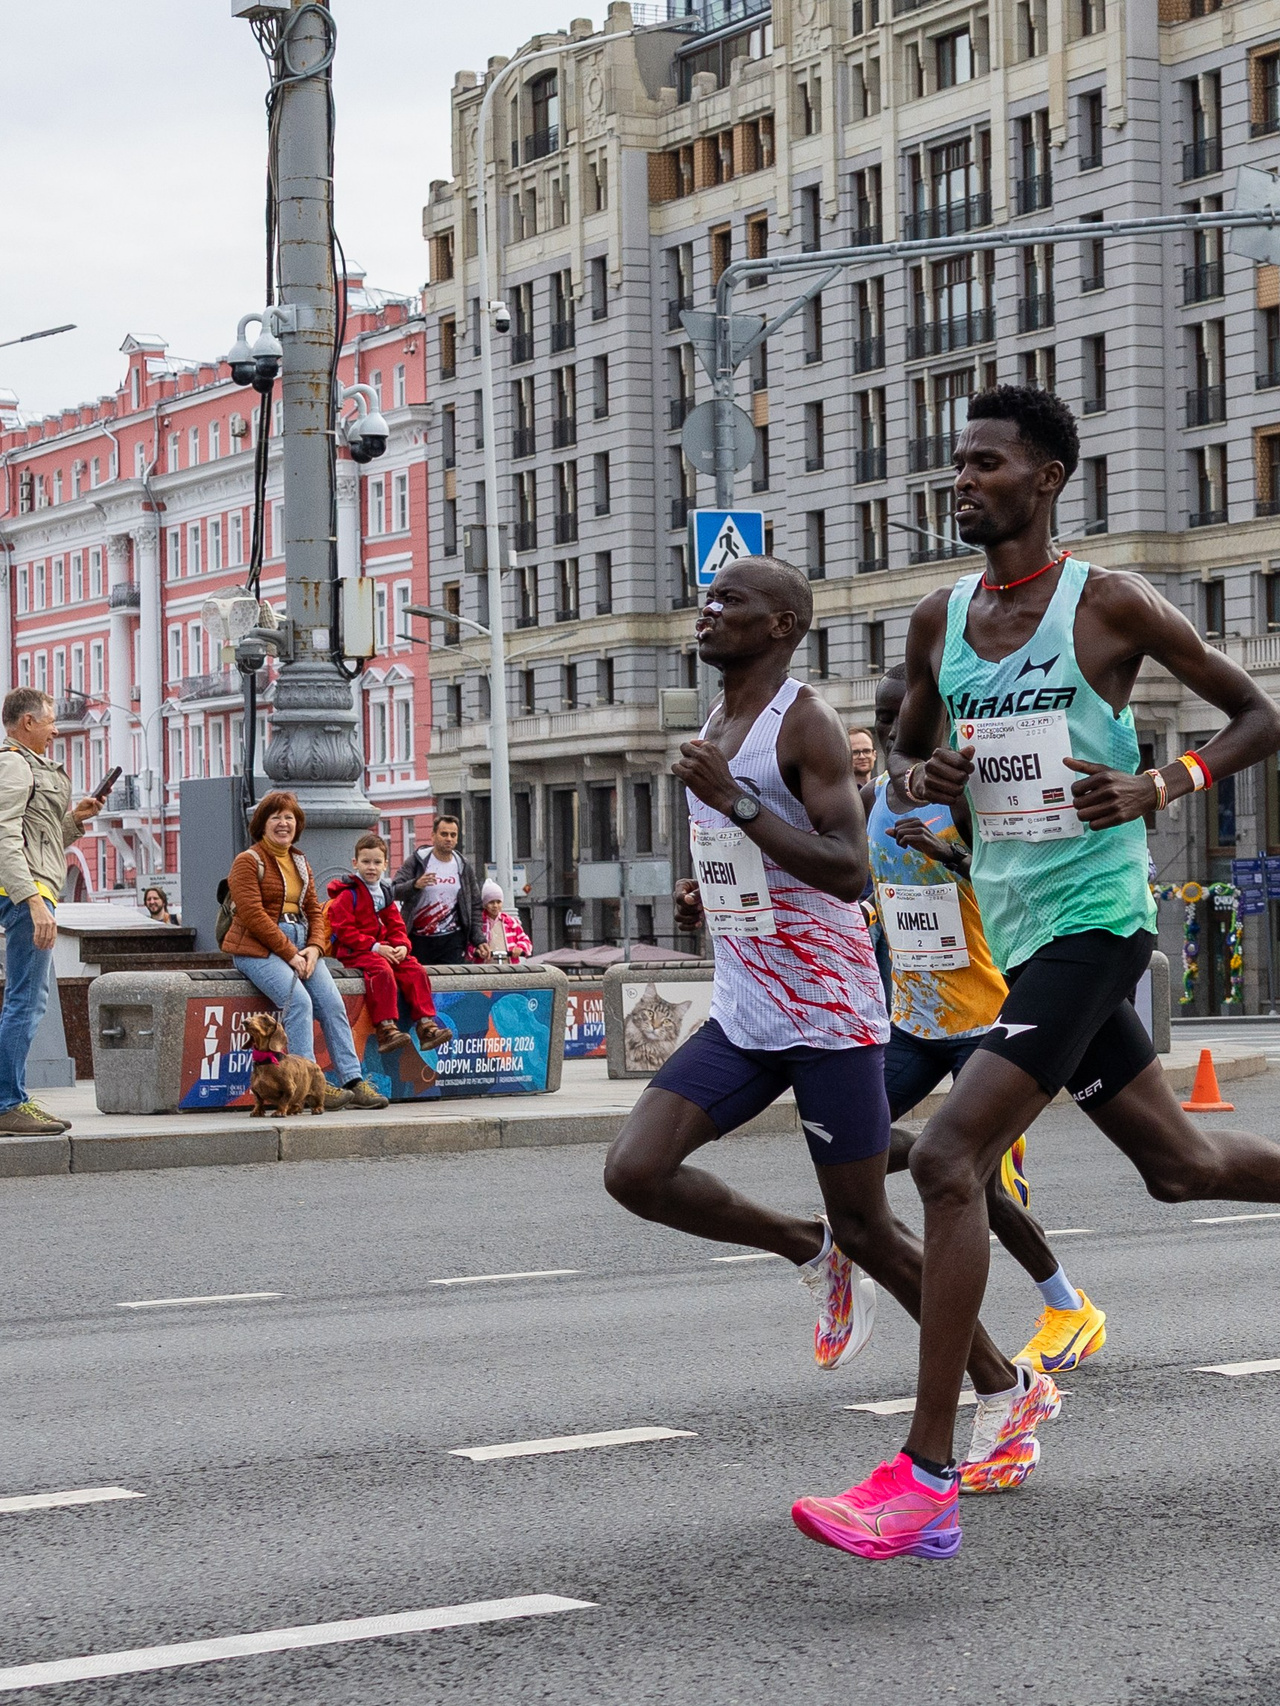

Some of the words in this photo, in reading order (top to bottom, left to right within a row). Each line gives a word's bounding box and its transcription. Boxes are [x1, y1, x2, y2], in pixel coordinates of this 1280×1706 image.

[977, 726, 1015, 734] МОСКОВСКИЙ
[1026, 728, 1047, 737] 2026
[977, 753, 1042, 784] KOSGEI
[1007, 795, 1019, 806] 15
[719, 895, 726, 905] 5
[896, 912, 939, 930] KIMELI
[917, 939, 923, 947] 2
[437, 1039, 464, 1055] 28-30
[465, 1037, 512, 1054] СЕНТЯБРЯ
[514, 1036, 535, 1052] 2026
[228, 1053, 253, 1073] БРИ
[436, 1059, 473, 1075] ФОРУМ.
[475, 1056, 524, 1073] ВЫСТАВКА
